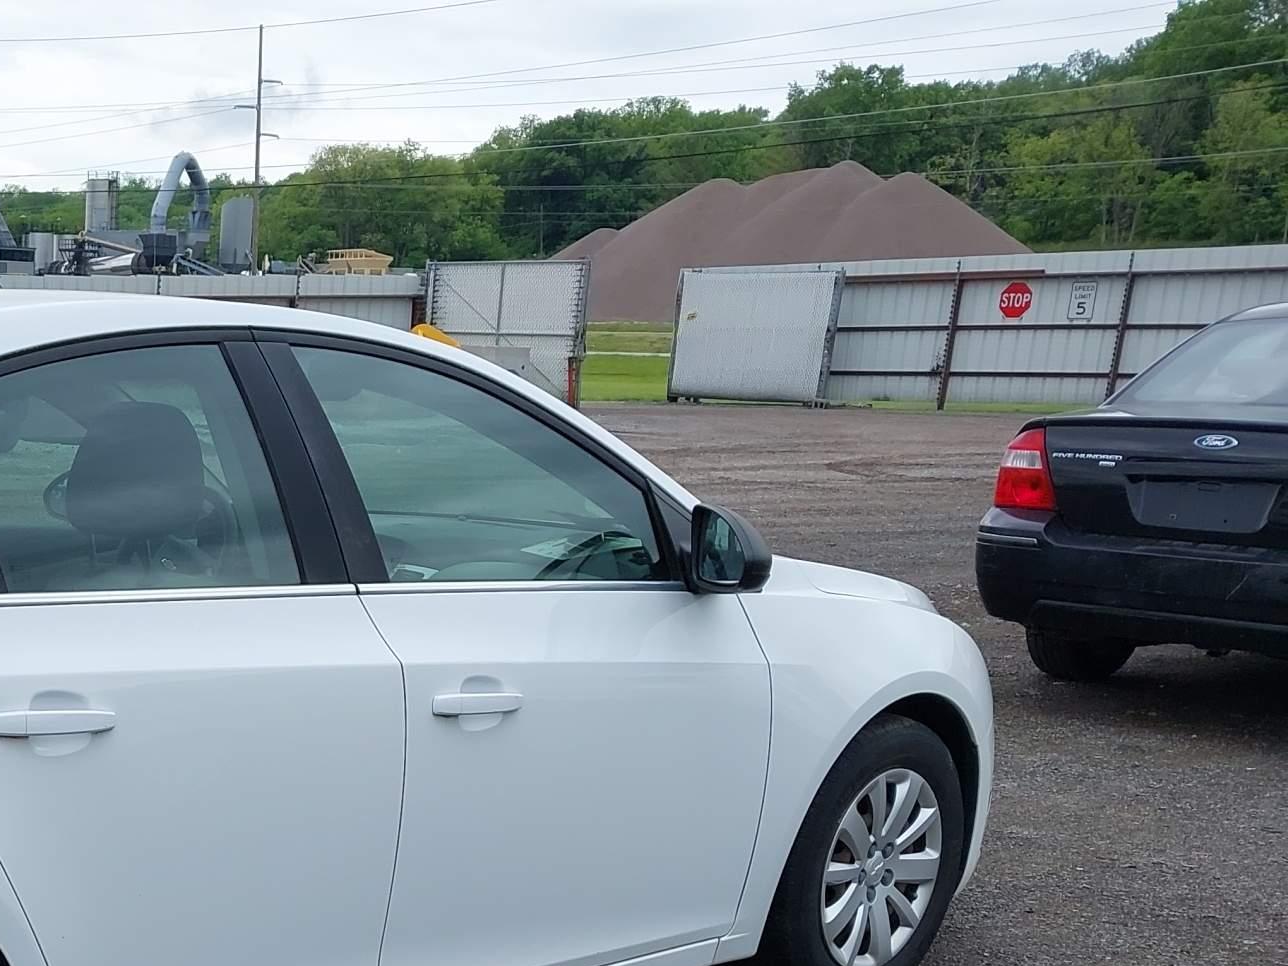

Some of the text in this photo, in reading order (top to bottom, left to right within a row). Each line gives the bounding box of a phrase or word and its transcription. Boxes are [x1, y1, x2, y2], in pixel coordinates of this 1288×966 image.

[1001, 293, 1031, 308] STOP
[1075, 301, 1087, 315] 5
[1075, 452, 1123, 461] HUNDRED
